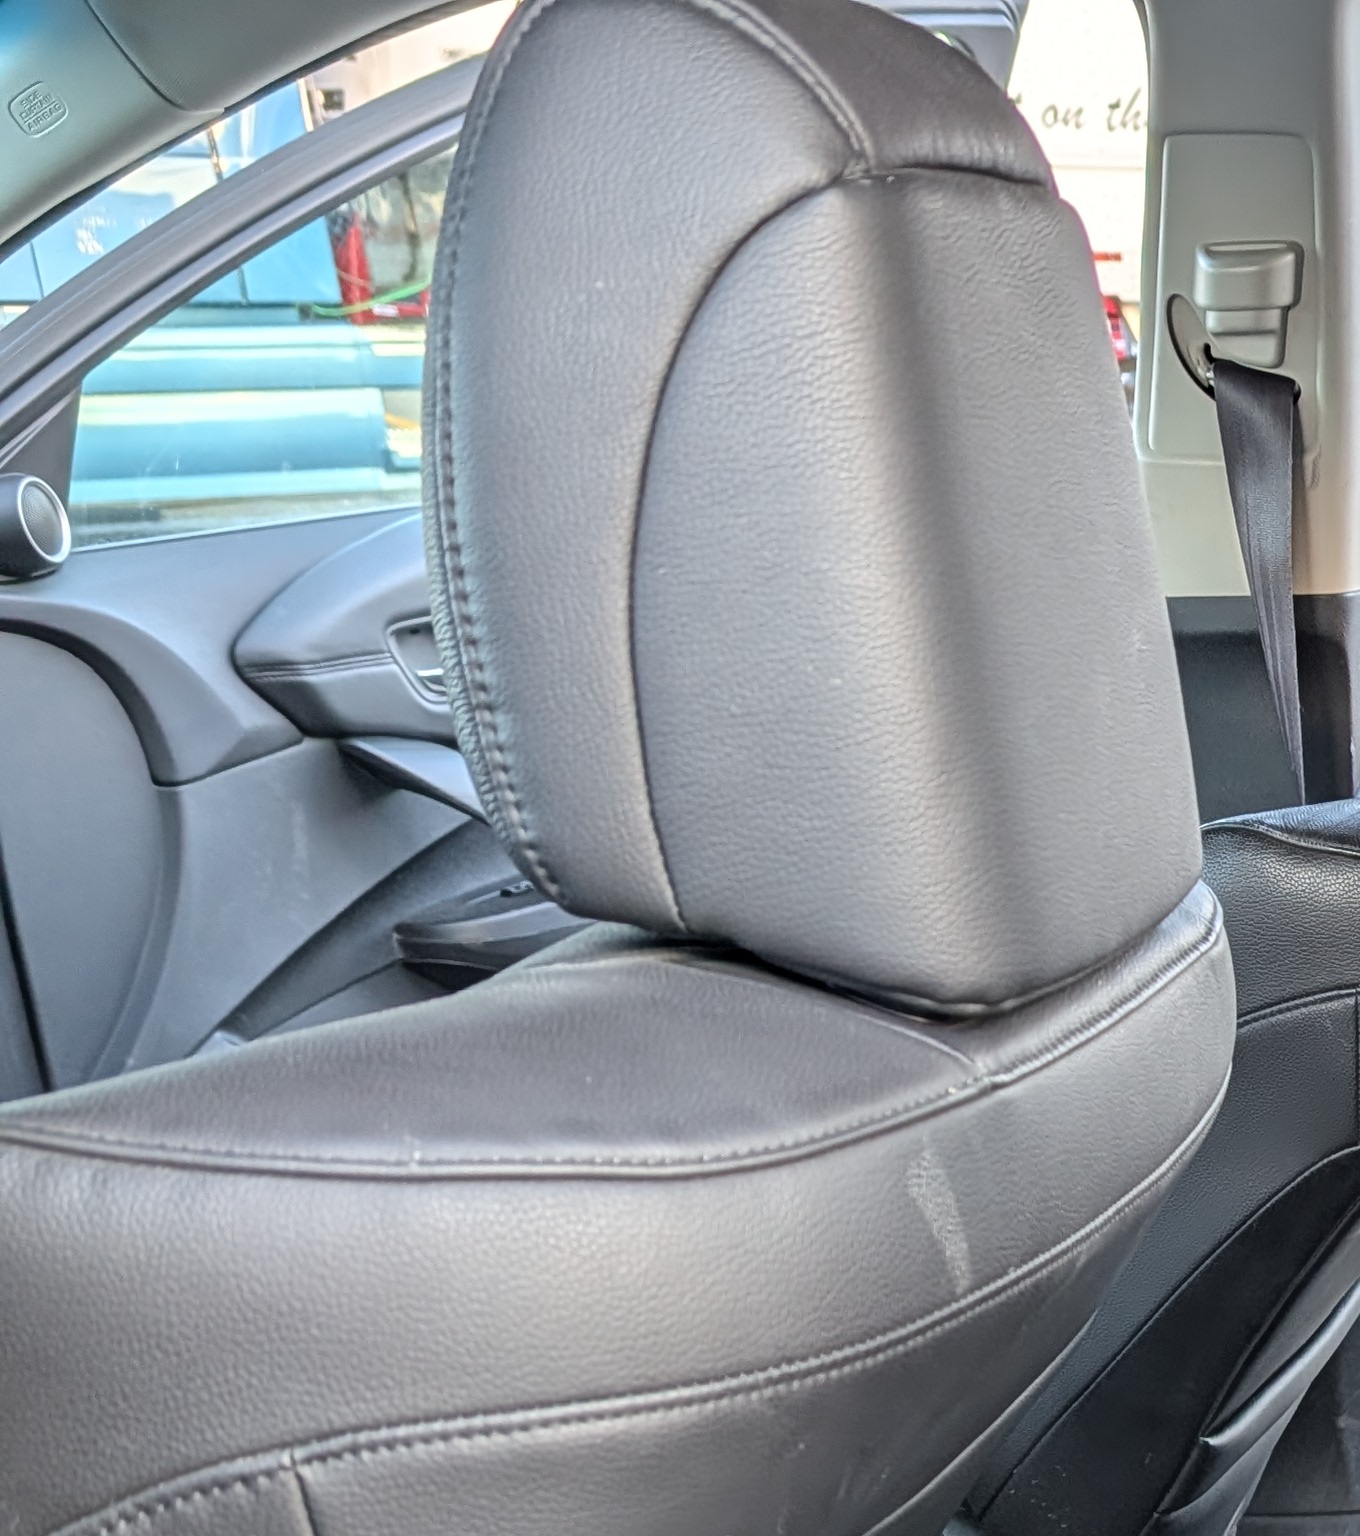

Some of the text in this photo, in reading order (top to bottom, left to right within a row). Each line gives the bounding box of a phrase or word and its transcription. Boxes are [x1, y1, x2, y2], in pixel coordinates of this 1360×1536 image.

[27, 103, 62, 132] AIRBAG
[1041, 87, 1148, 132] on th
